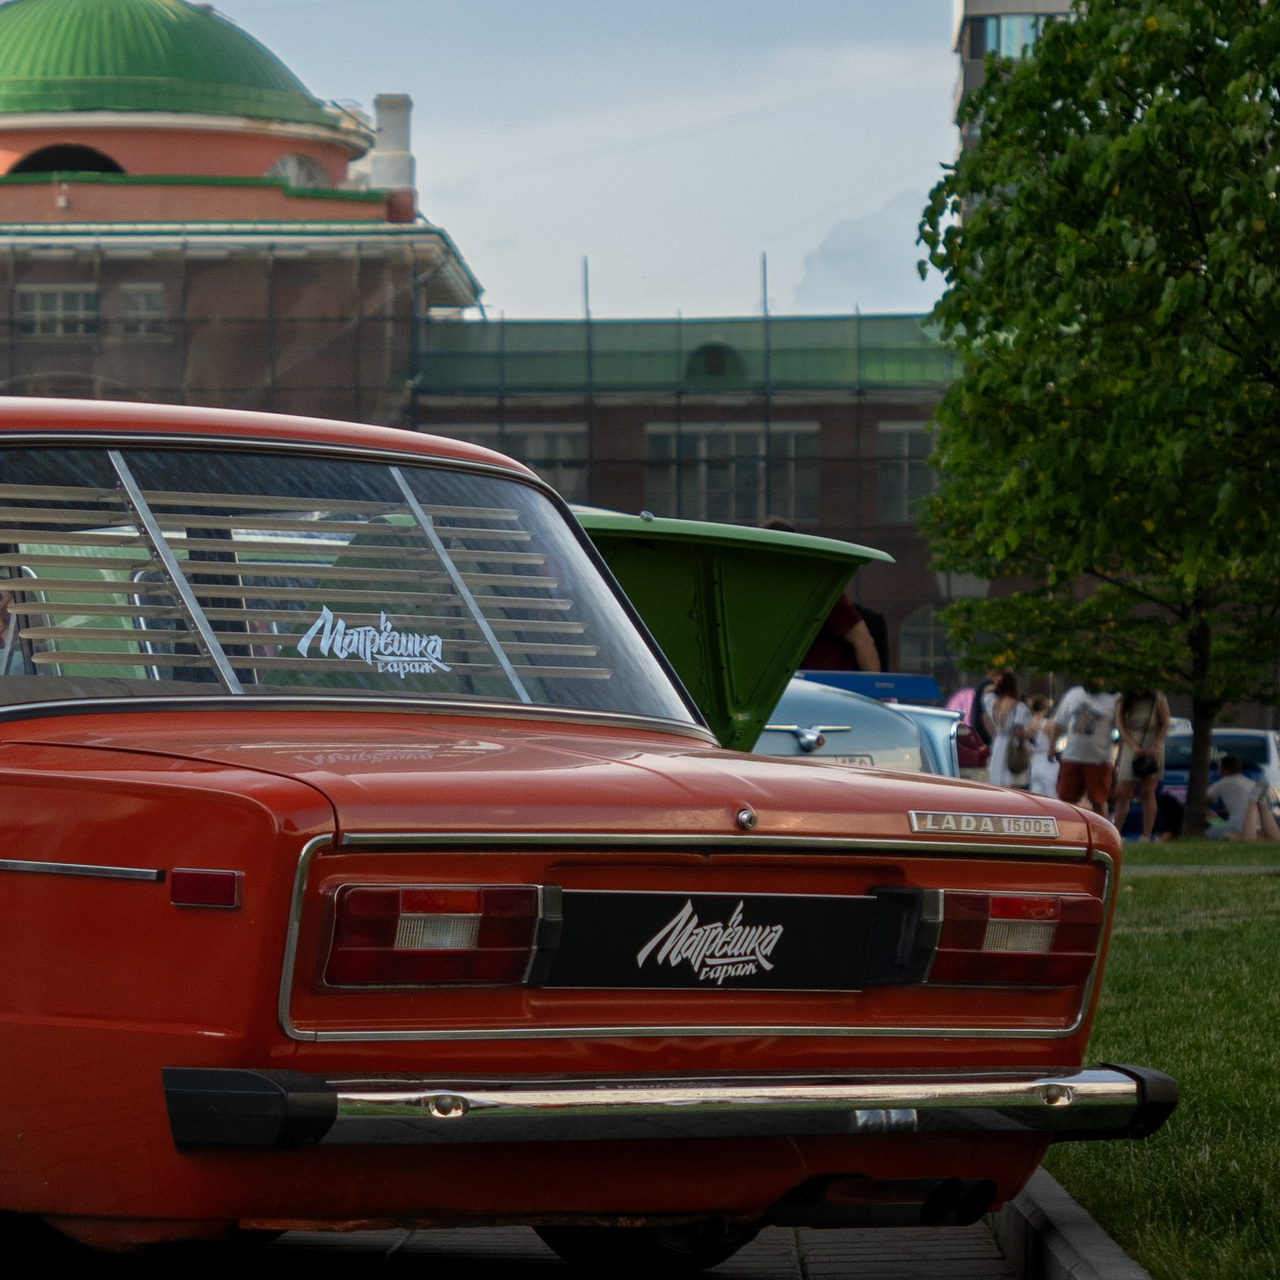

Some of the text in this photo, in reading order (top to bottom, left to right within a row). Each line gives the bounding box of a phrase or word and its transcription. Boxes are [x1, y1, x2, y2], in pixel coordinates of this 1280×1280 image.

[377, 662, 437, 679] гараж
[926, 814, 994, 832] LADA
[699, 962, 758, 985] гараж
